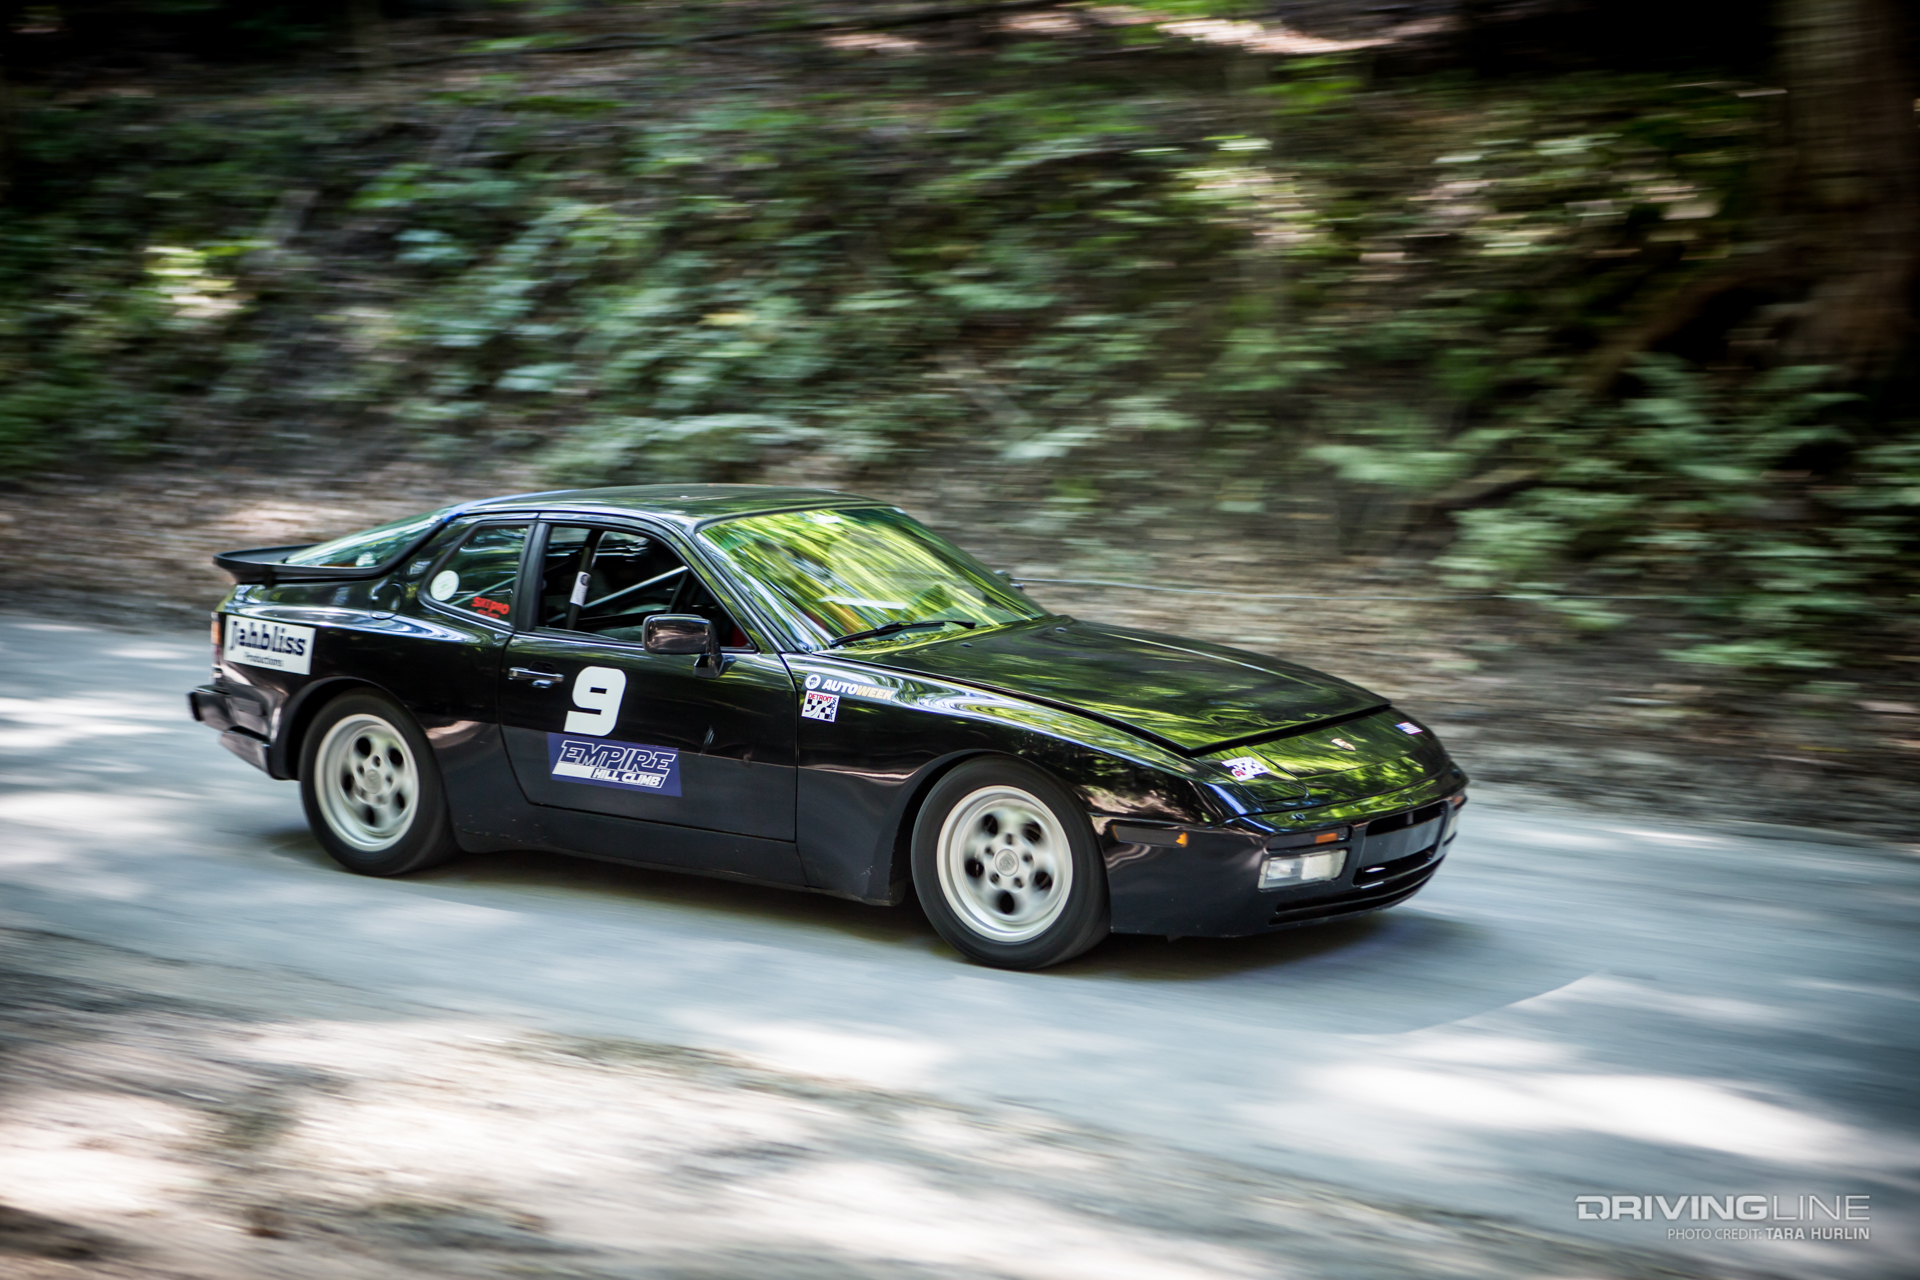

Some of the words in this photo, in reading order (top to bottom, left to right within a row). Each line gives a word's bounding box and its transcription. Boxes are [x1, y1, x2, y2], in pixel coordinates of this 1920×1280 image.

[808, 692, 833, 702] DETROIT
[821, 678, 895, 701] AUTOWEEK
[563, 666, 627, 737] 9
[558, 740, 677, 777] EMPIRE
[592, 768, 620, 781] HILL
[621, 773, 662, 787] CLIMB
